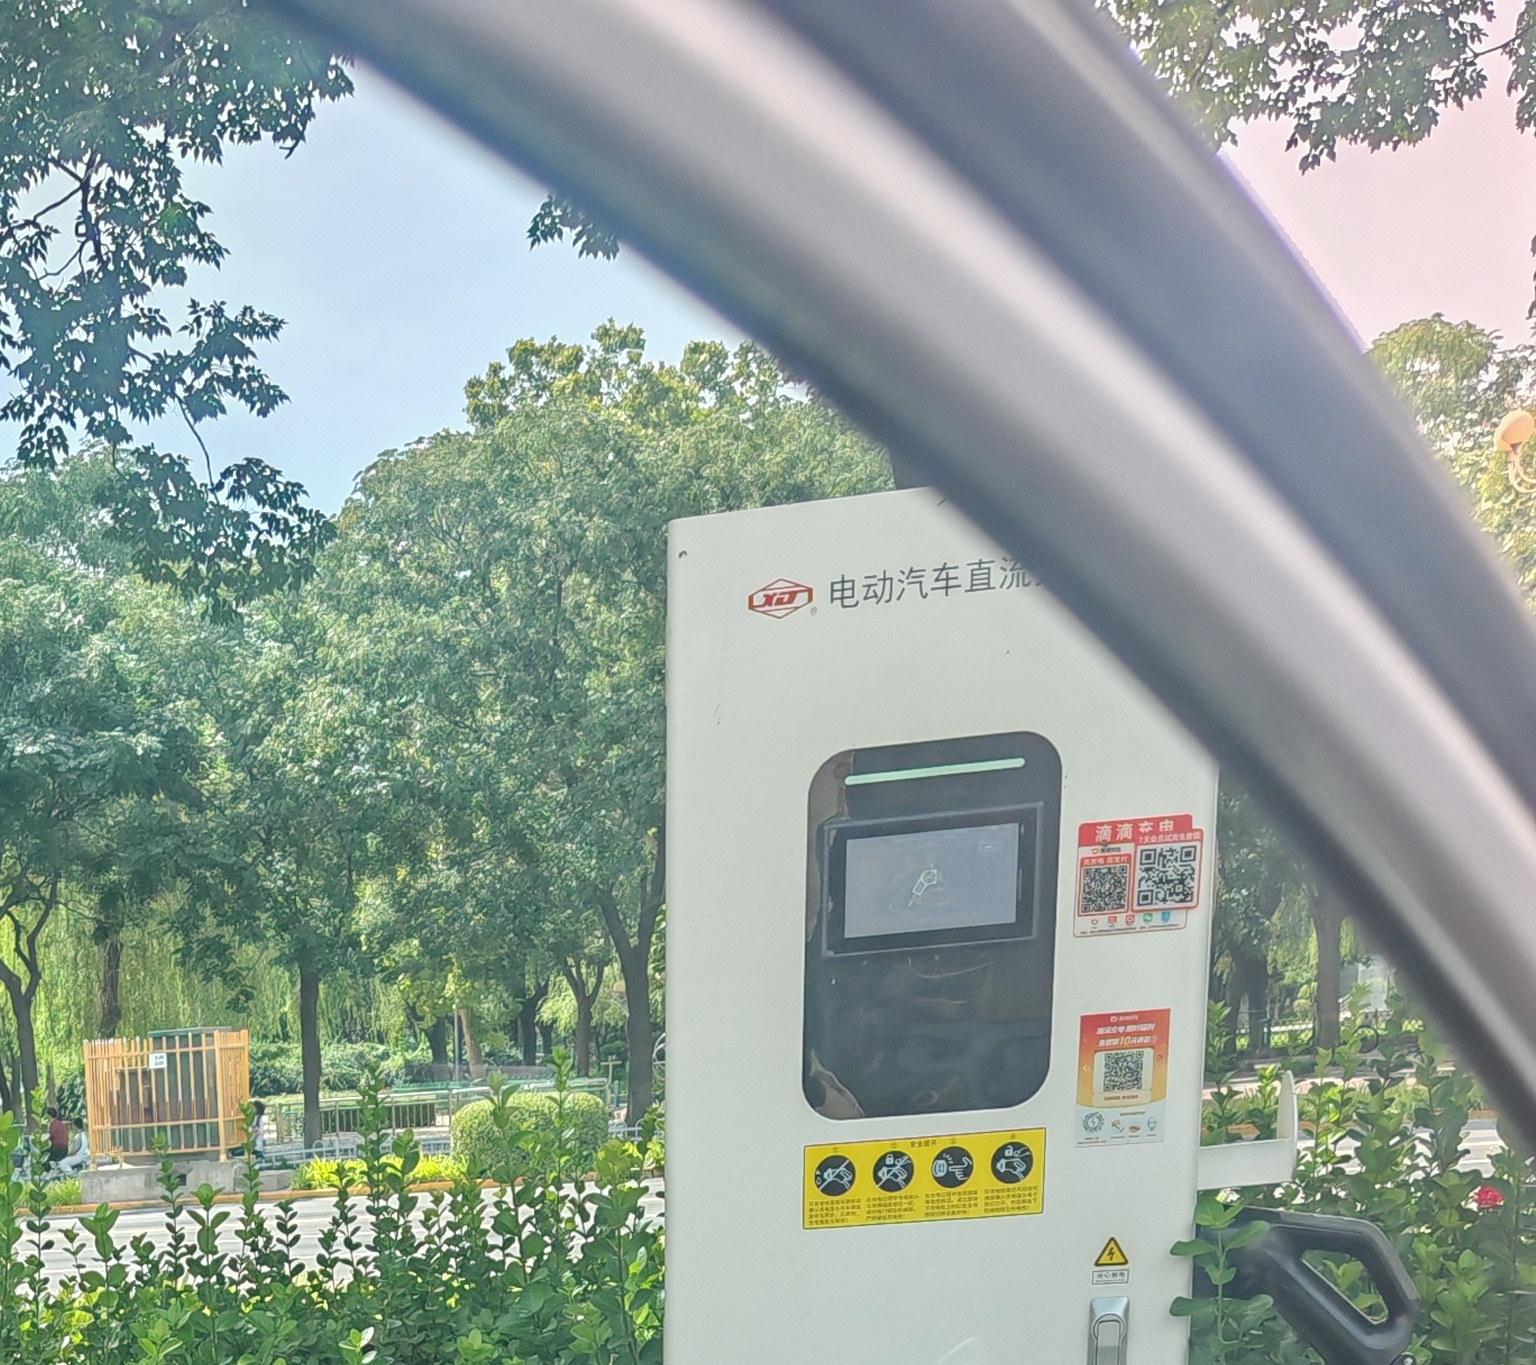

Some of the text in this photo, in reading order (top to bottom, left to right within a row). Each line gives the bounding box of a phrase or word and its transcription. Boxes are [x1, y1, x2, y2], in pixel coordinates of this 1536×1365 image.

[829, 557, 1044, 609] 电动汽车直流
